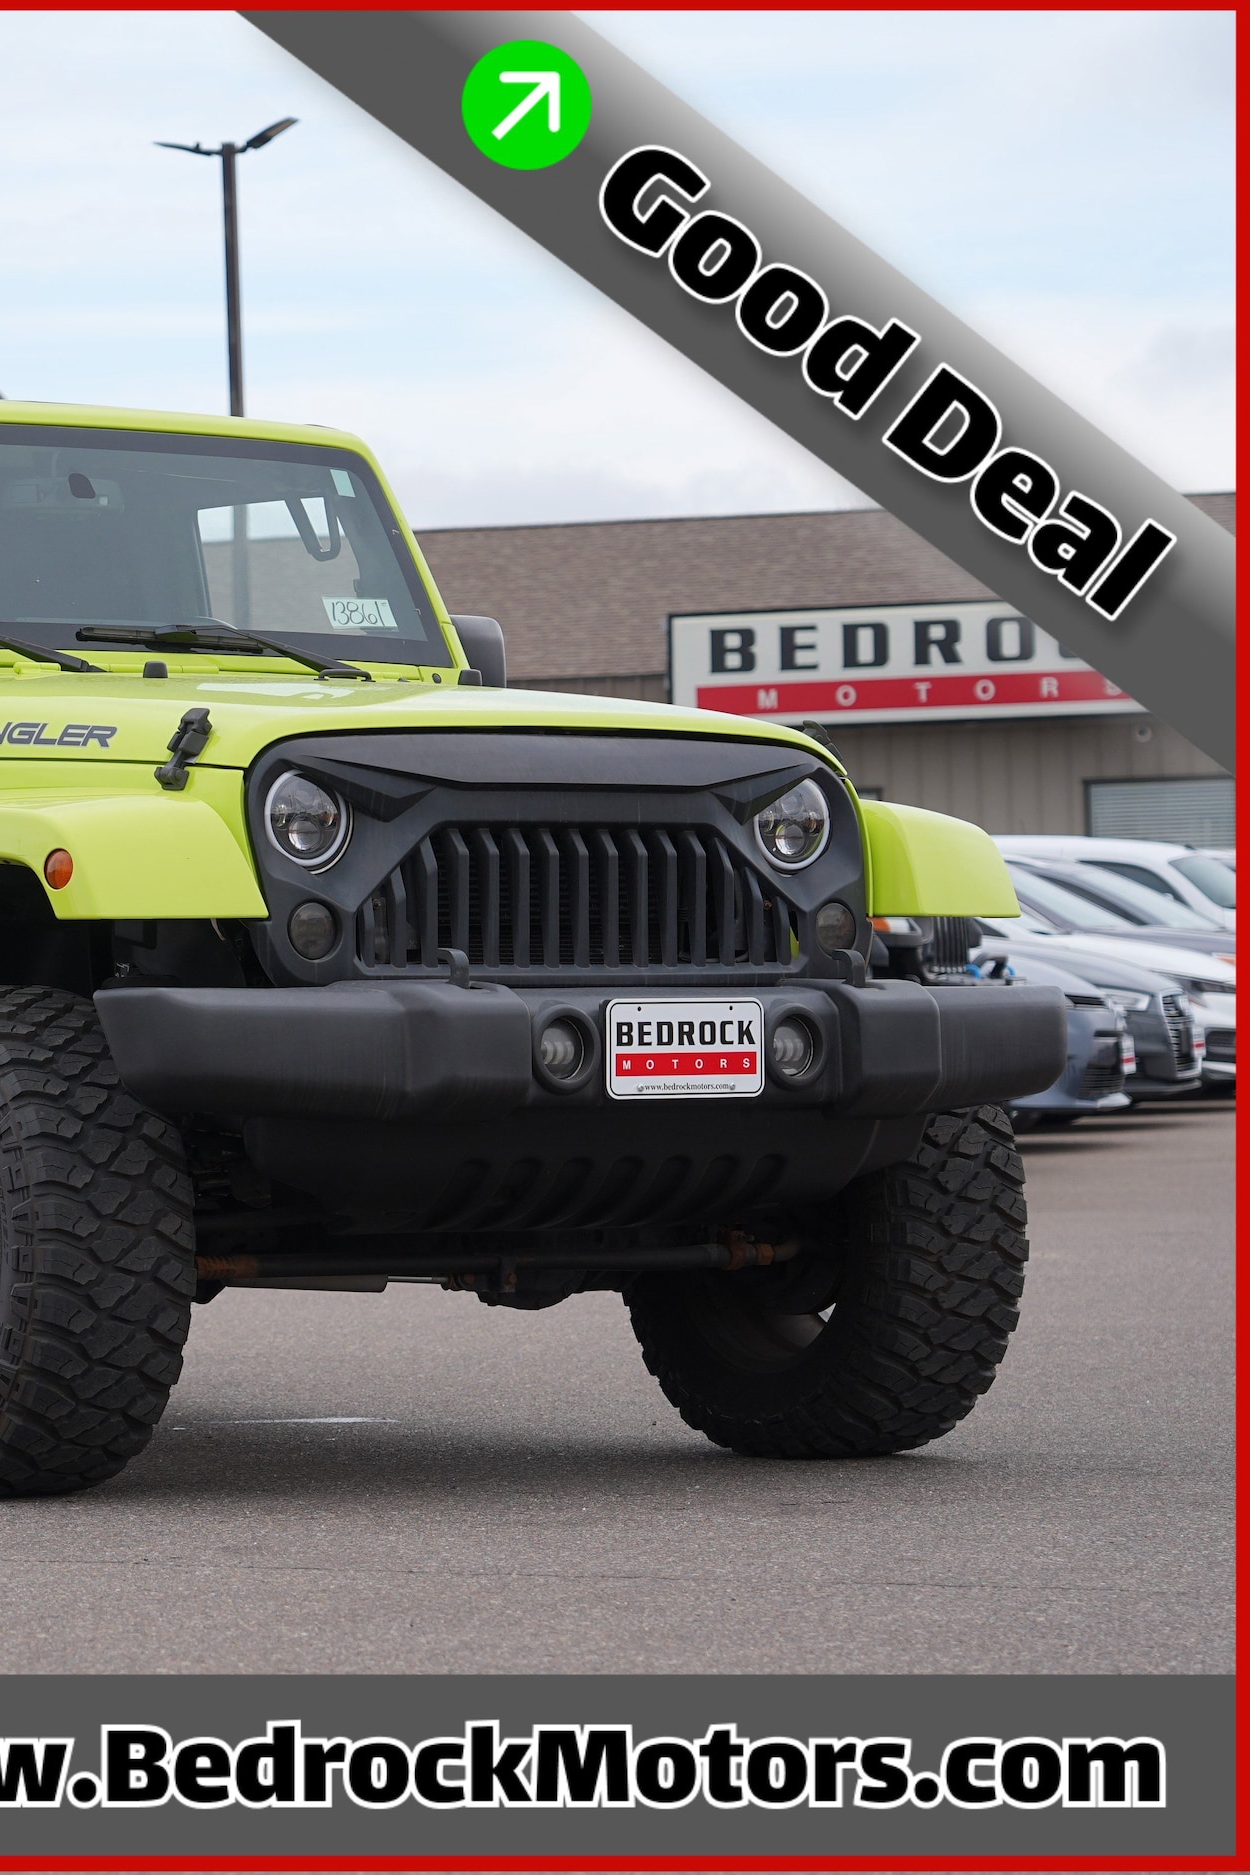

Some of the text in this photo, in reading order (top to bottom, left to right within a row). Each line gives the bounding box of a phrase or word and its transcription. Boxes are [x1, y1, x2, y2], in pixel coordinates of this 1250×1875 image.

[332, 601, 385, 626] 13861
[710, 616, 1076, 673] BEDRO
[616, 1020, 756, 1047] BEDROCK
[622, 1058, 751, 1070] MOTORS
[644, 1082, 729, 1091] www.bedrockmotors.com
